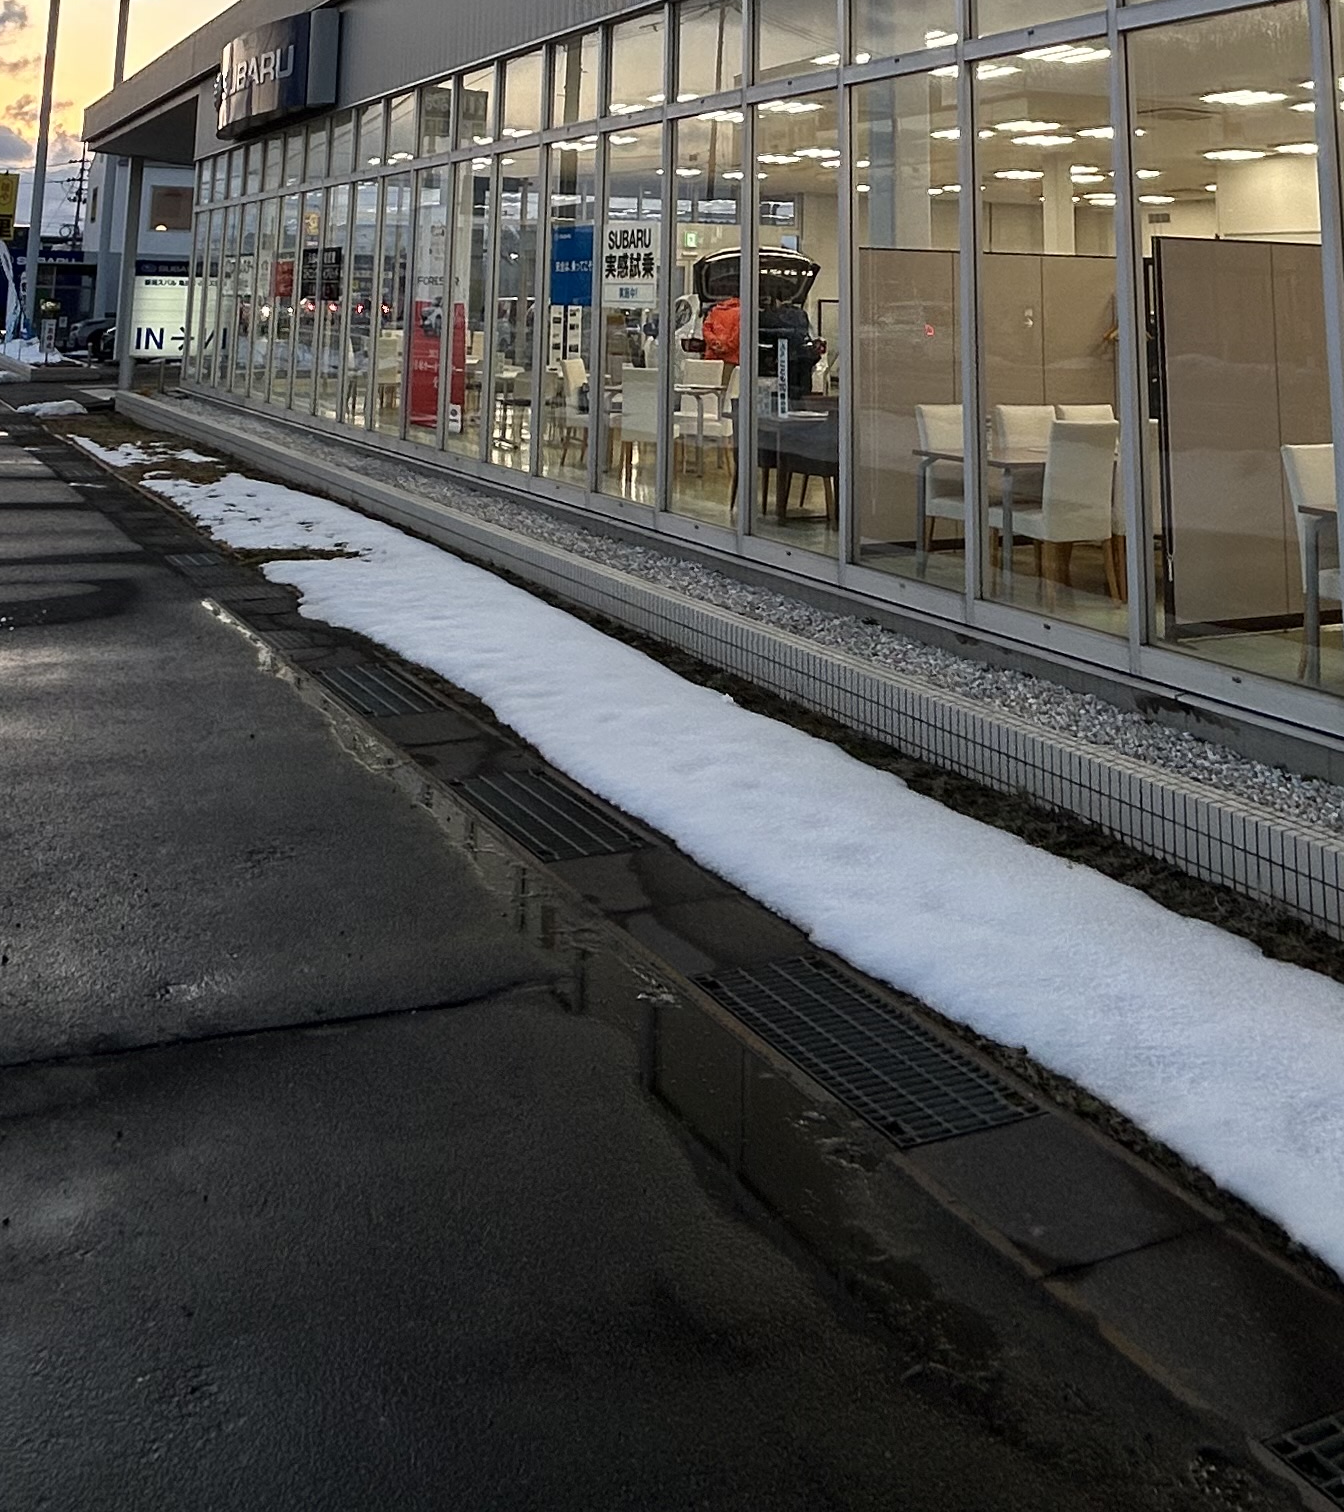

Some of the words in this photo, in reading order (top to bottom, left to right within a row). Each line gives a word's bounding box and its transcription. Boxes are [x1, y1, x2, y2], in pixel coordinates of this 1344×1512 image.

[608, 228, 652, 250] SUBARU
[604, 251, 654, 279] 実感試乗
[417, 276, 460, 286] FORESR
[135, 327, 164, 350] IN
